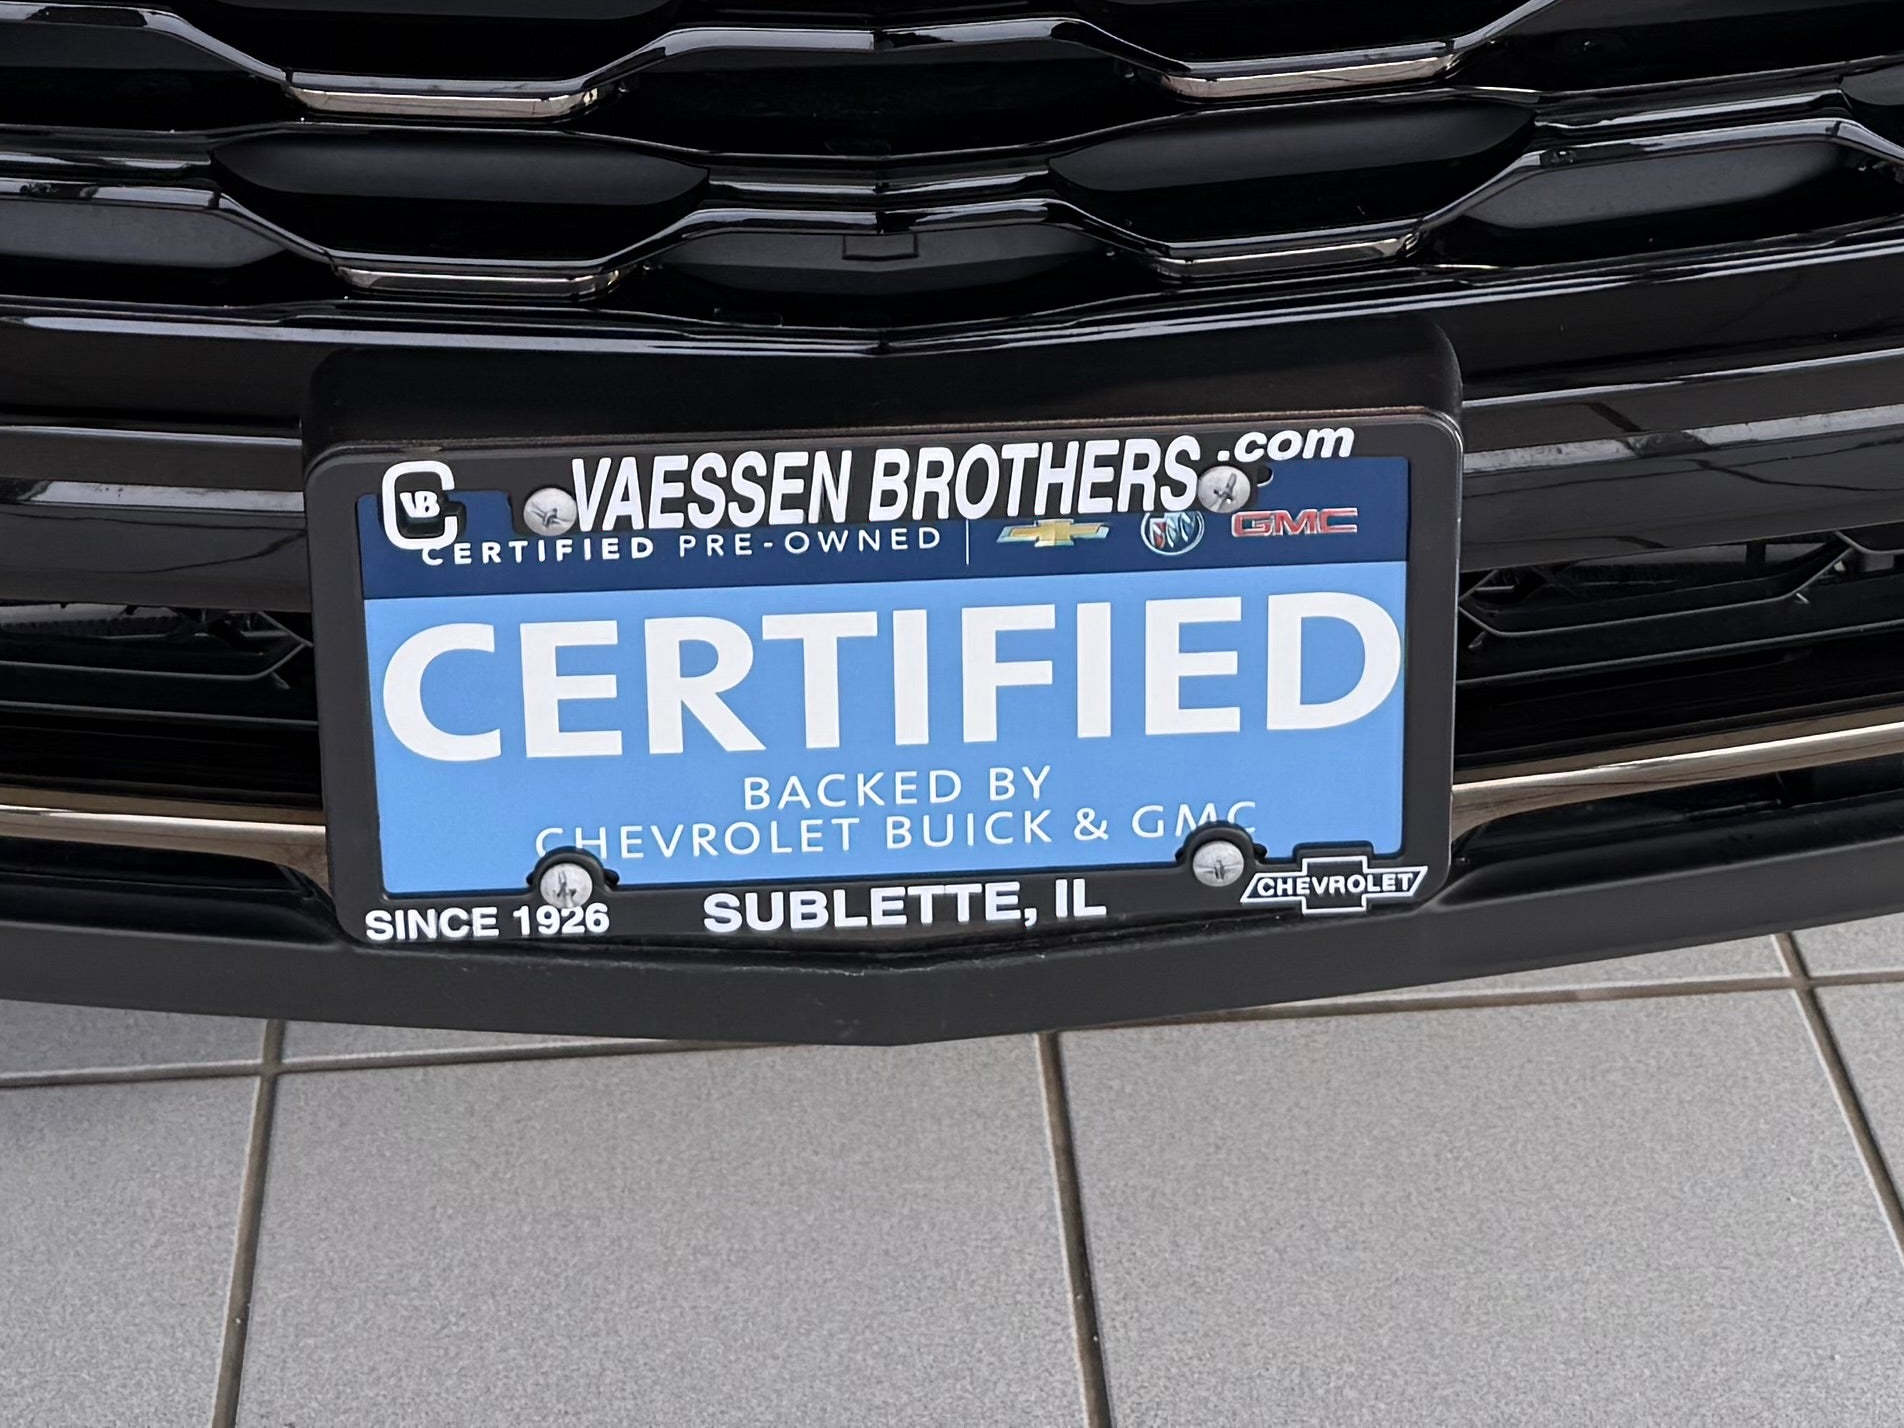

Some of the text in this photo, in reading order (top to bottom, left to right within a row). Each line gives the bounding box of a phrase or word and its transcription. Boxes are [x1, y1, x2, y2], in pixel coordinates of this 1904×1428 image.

[399, 491, 441, 518] VB
[572, 450, 853, 532] VAESSEN
[867, 434, 1201, 522] BROTHERS
[1231, 507, 1358, 537] GMC
[422, 526, 941, 566] CERTIFIED PRE-OWNED
[381, 591, 1404, 763] CERTIFIED
[744, 764, 1052, 810] BACKED BY
[535, 816, 860, 859] CHEVROLET
[886, 808, 1053, 850] BUICK
[1073, 806, 1109, 841] &
[703, 877, 1108, 932] SUBLETTE, IL
[1257, 872, 1414, 897] CHEVROLET
[365, 902, 611, 941] SINCE 1926
